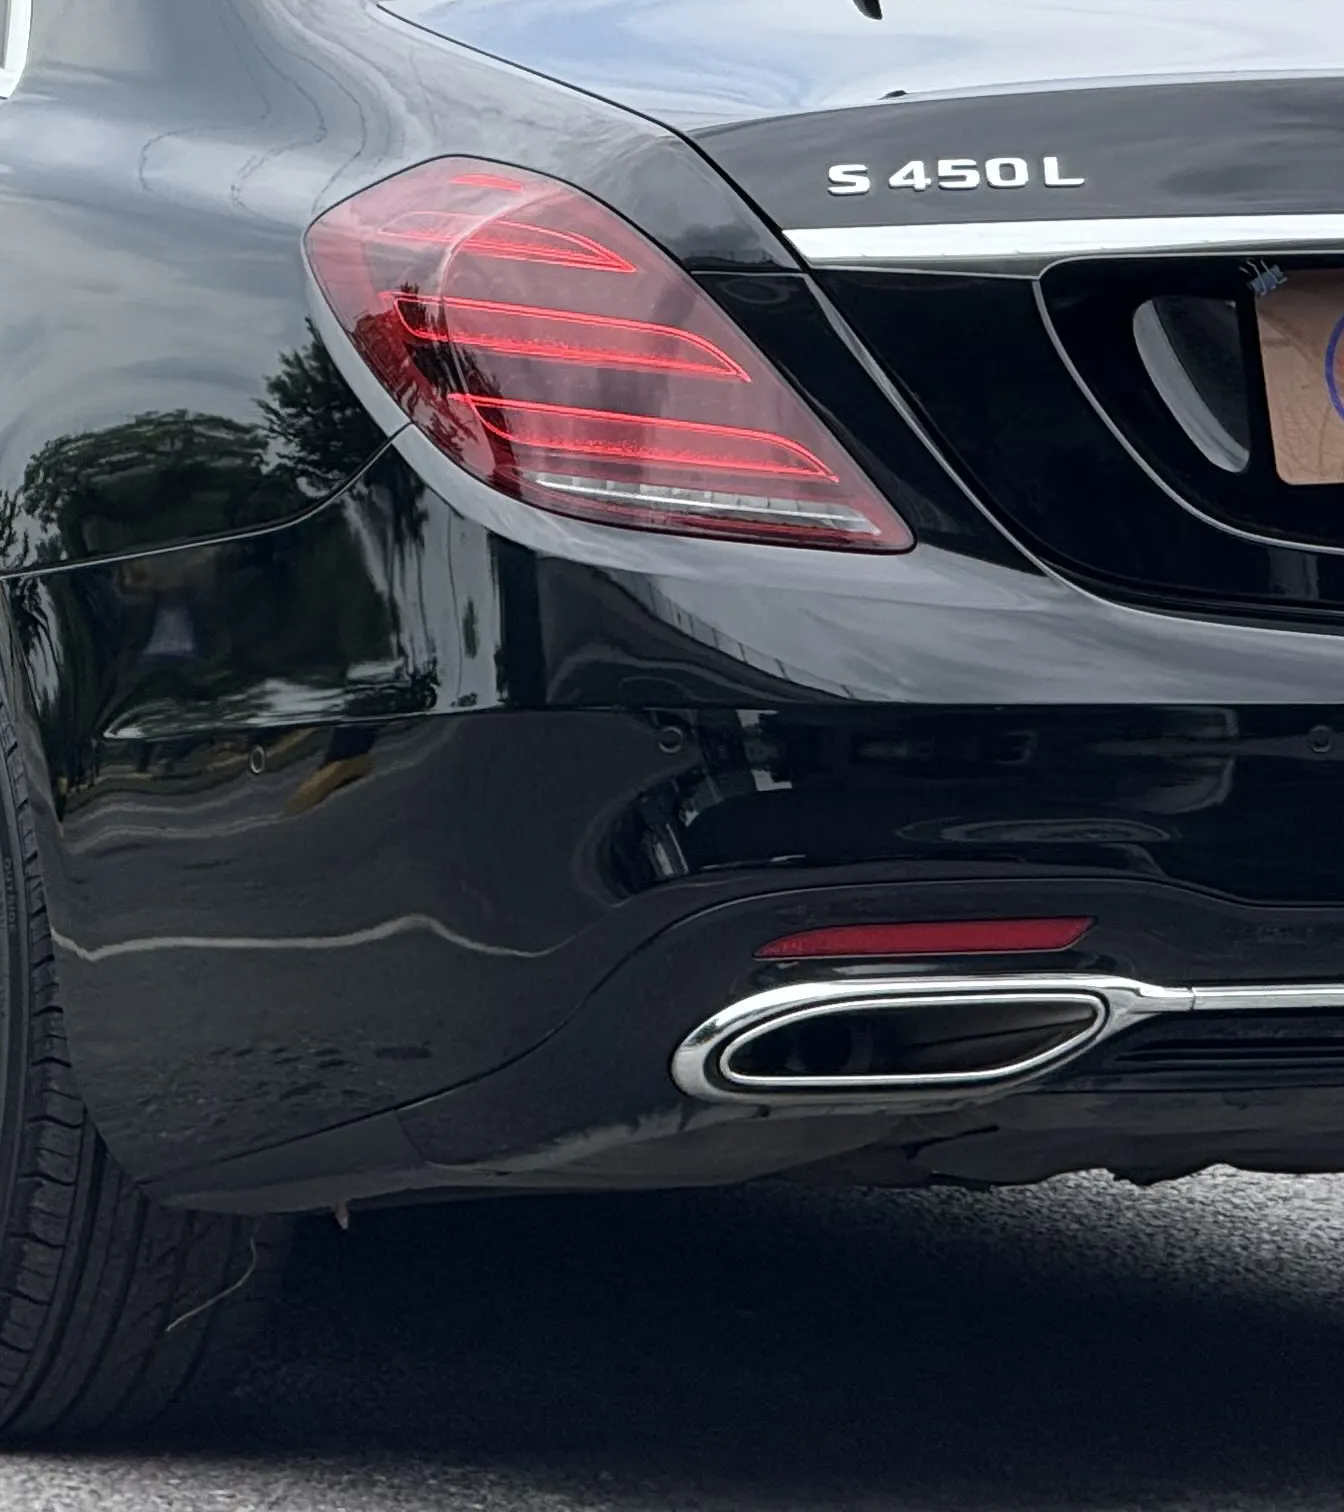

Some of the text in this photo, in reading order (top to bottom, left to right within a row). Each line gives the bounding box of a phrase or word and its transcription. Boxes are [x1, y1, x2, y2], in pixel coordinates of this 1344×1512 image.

[827, 156, 1085, 196] S 450 L
